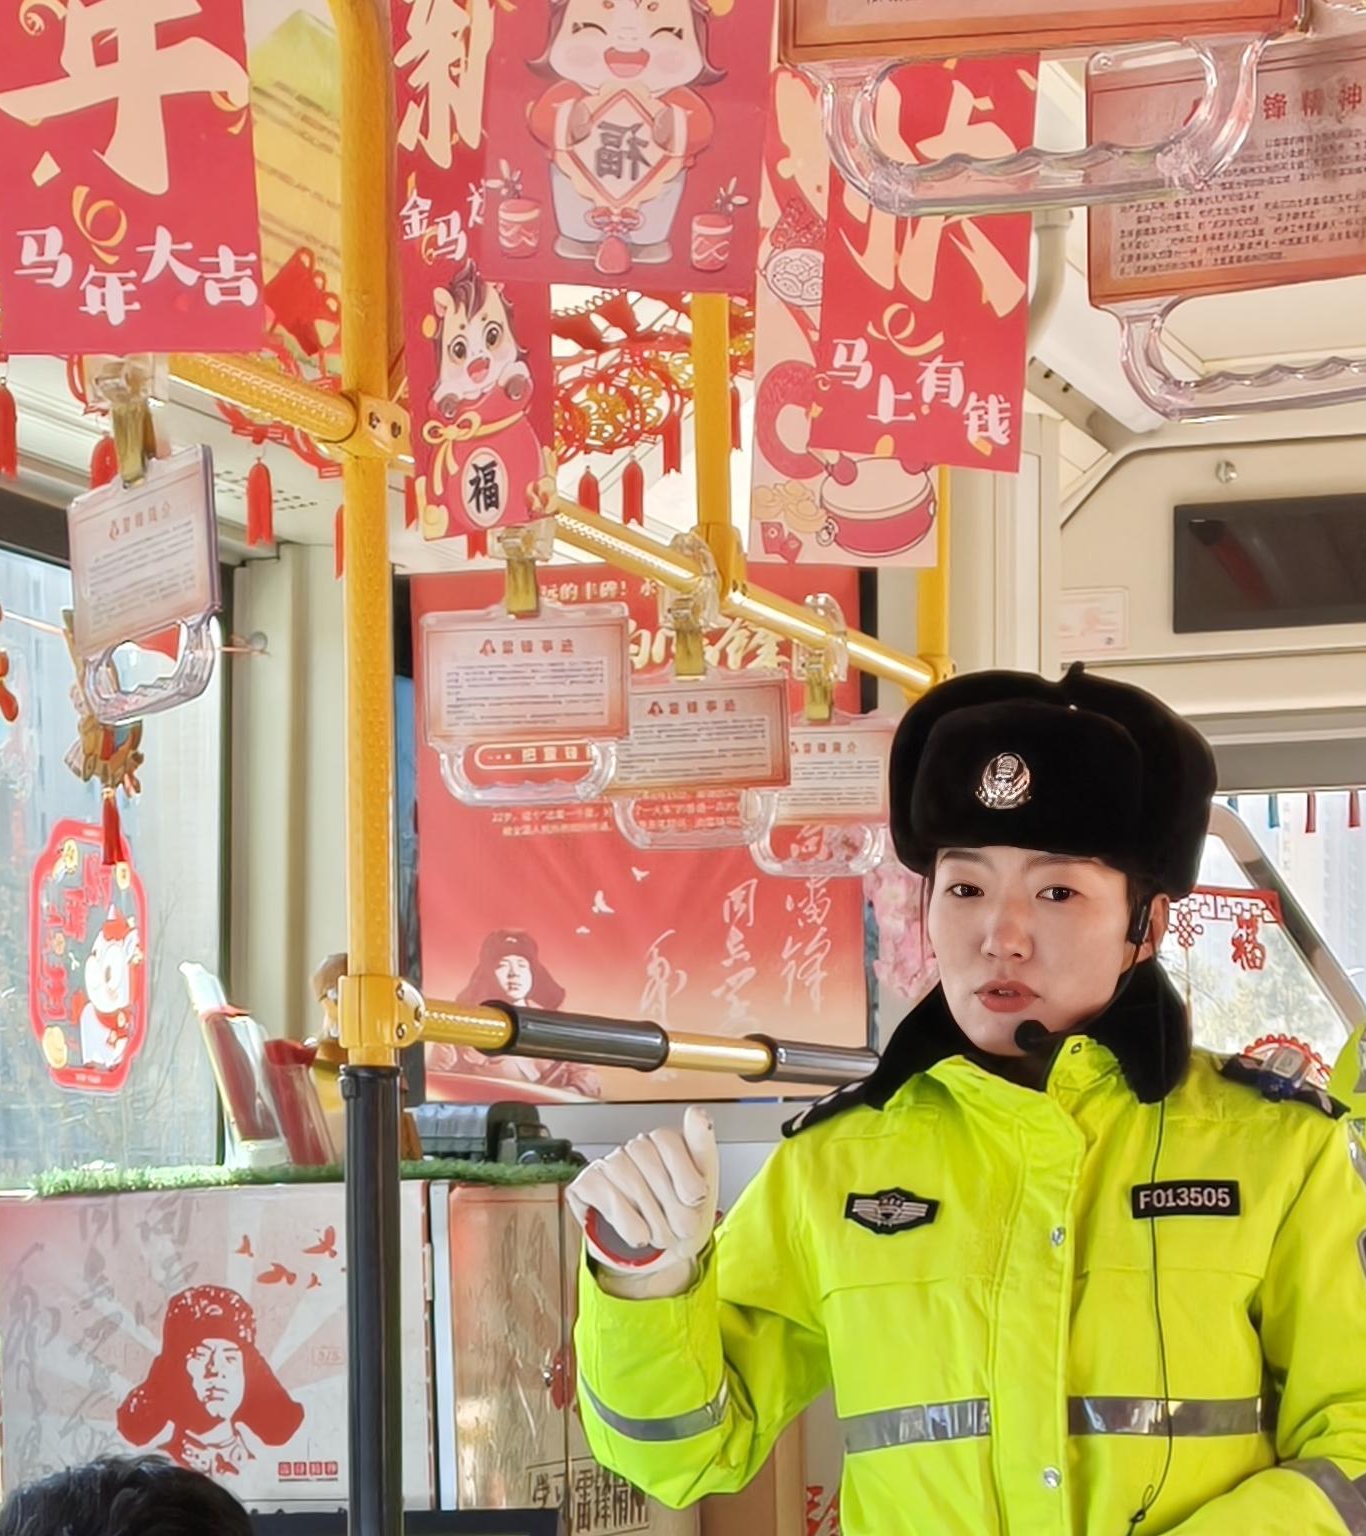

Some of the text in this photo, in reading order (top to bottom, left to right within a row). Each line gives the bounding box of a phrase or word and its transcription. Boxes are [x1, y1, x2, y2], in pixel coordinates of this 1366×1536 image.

[1263, 83, 1362, 121] 锋精神
[14, 225, 259, 327] 马年大吉
[827, 338, 1012, 447] 马上有钱
[467, 462, 501, 513] 福
[1138, 1187, 1232, 1210] F013505
